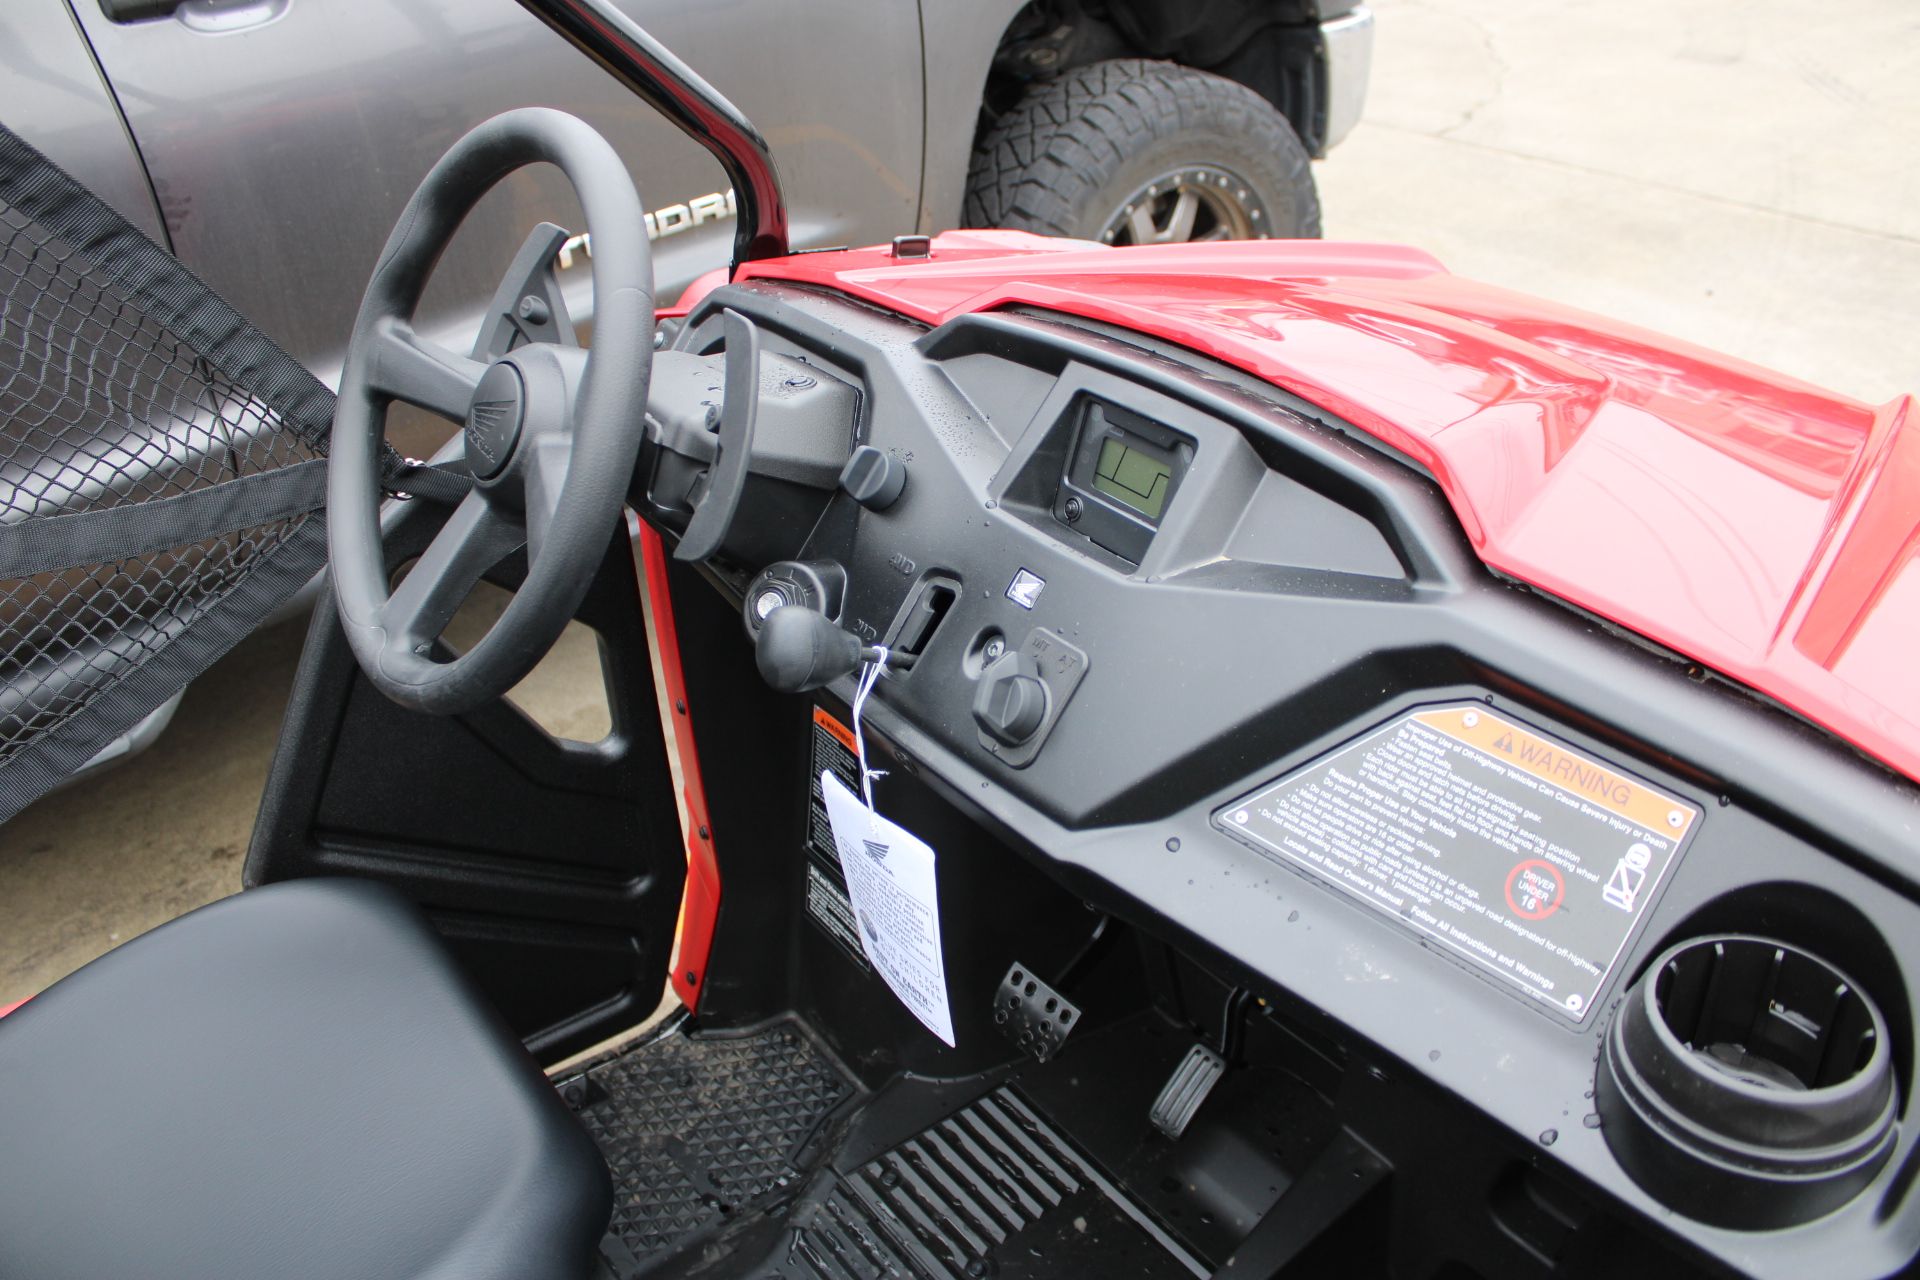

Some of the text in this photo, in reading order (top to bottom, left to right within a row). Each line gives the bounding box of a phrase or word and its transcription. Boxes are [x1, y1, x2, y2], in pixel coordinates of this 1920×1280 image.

[1408, 734, 1446, 758] Prepared
[1515, 739, 1634, 807] WARNING
[1327, 767, 1358, 788] Require
[1356, 782, 1384, 802] Proper
[1383, 796, 1400, 809] Use
[1408, 808, 1428, 823] Your
[1427, 818, 1457, 838] Vehicle
[1404, 721, 1438, 743] Improper
[1437, 736, 1455, 750] Use
[1460, 748, 1506, 775] Off-Highway
[1505, 768, 1538, 789] Vehicles
[1537, 783, 1555, 797] Can
[1554, 791, 1581, 809] Cause
[1579, 803, 1609, 822] Severe
[1607, 816, 1632, 835] Injury
[1642, 833, 1668, 850] Death
[1283, 835, 1308, 854] Locate
[1307, 849, 1324, 862] and
[1323, 858, 1344, 874] Read
[1374, 886, 1403, 906] Manual
[1516, 879, 1549, 902] UNDER
[1518, 893, 1537, 910] 16
[1521, 869, 1555, 892] DRIVER
[1410, 905, 1438, 925] Follow
[1448, 926, 1498, 958] Instructions
[1497, 953, 1514, 967] and
[1513, 962, 1555, 991] Warnings
